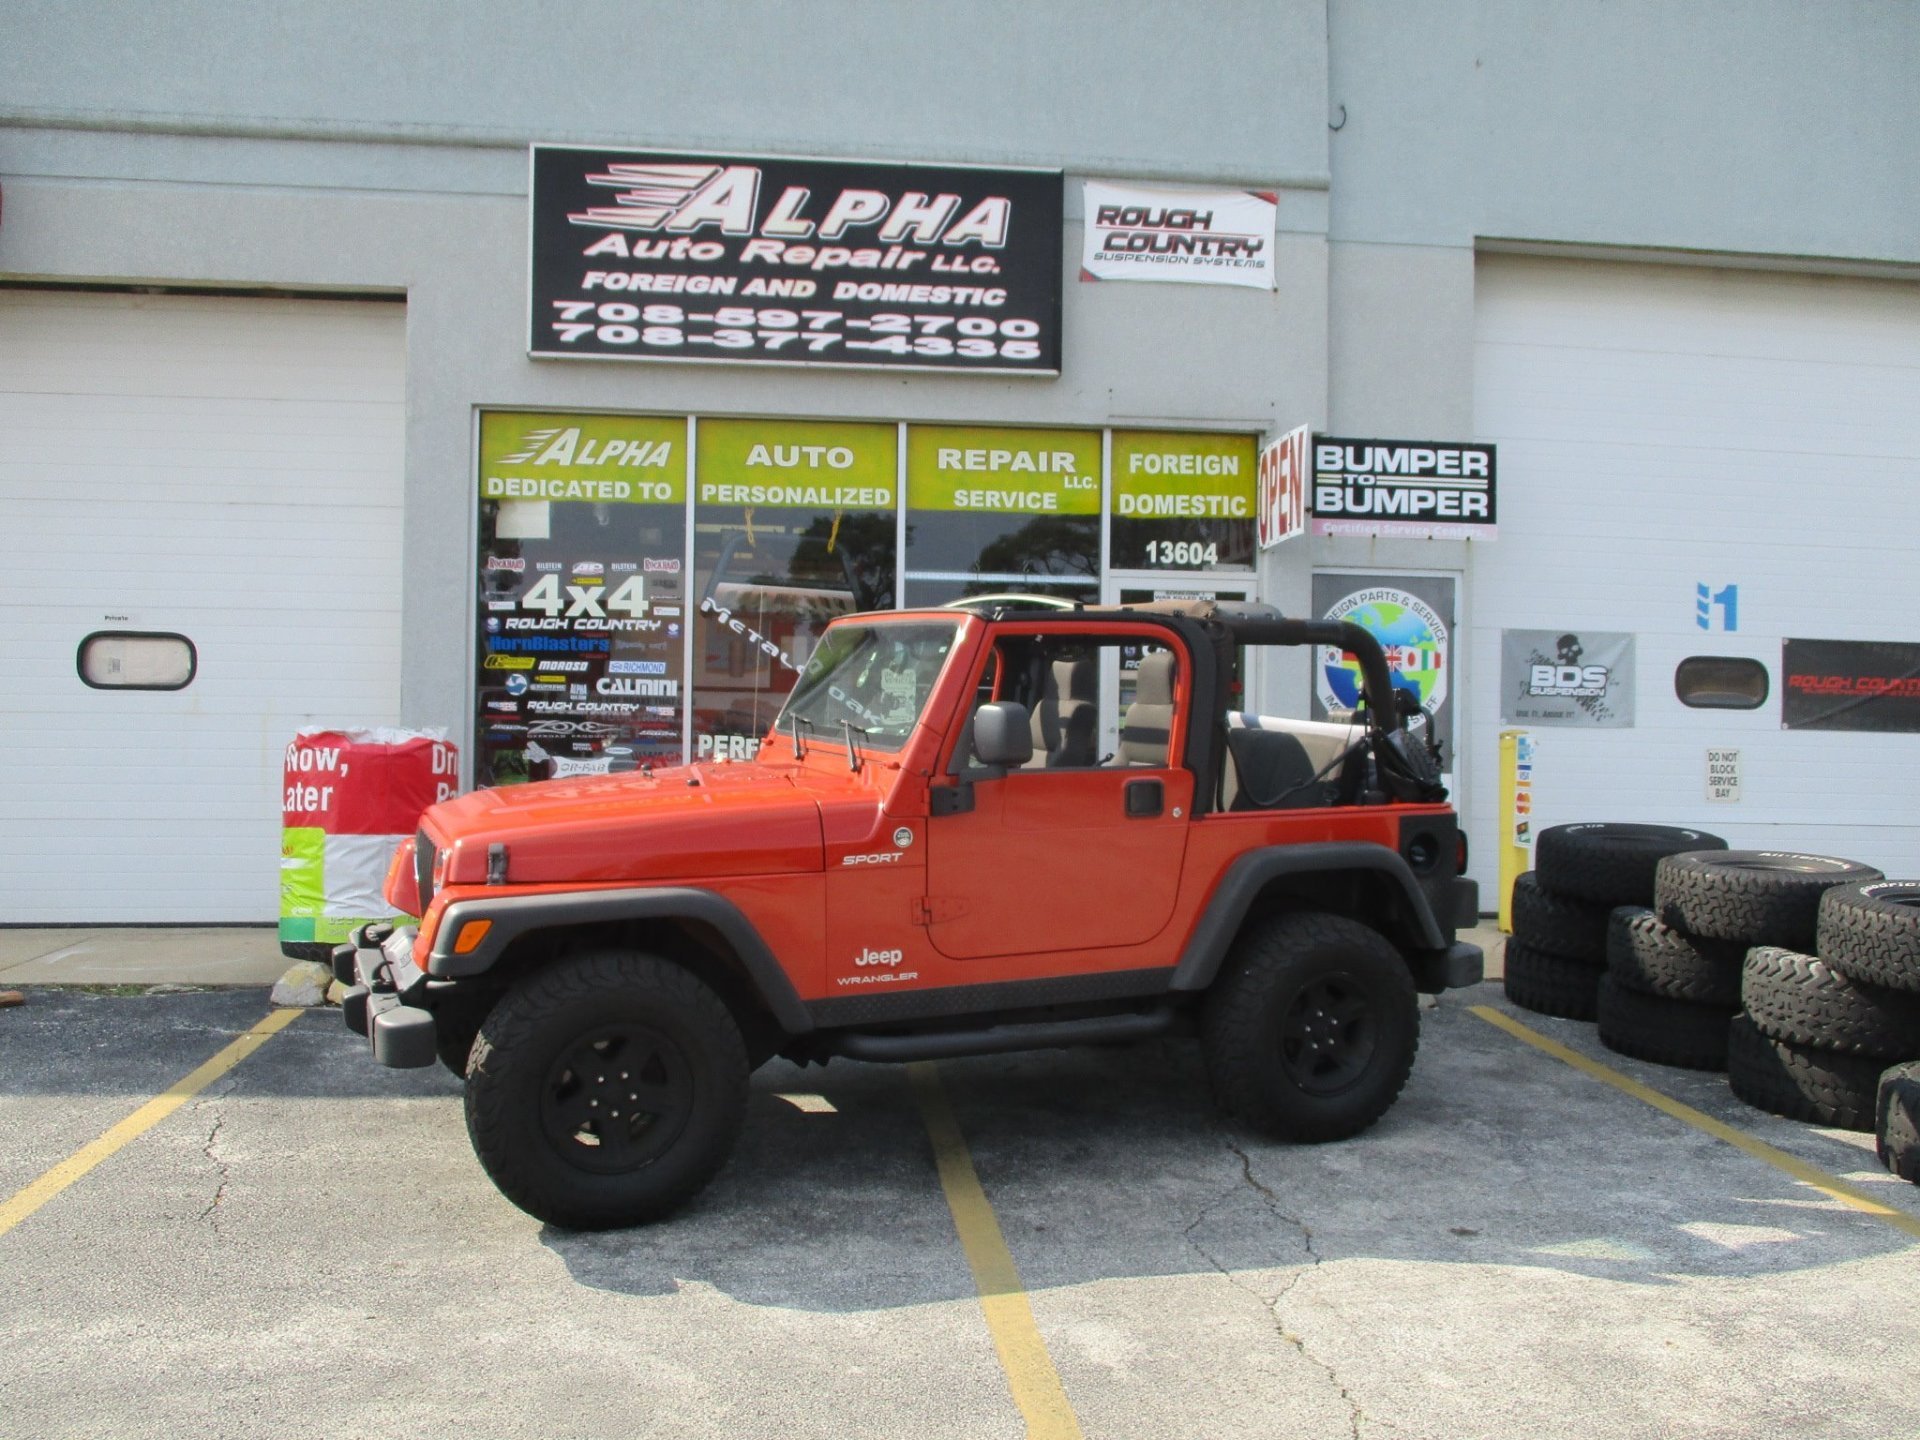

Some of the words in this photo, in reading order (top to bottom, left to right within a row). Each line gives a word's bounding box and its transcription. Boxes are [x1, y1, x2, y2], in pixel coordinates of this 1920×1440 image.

[664, 165, 1011, 248] ALPHA
[1096, 204, 1214, 231] ROUGH
[583, 232, 725, 262] Auto
[739, 238, 927, 271] Repair
[931, 254, 1001, 275] LLC.
[1103, 231, 1265, 258] COUNTRY
[1093, 252, 1190, 264] SUSPENSION
[1193, 256, 1265, 269] SYSTEMS
[581, 270, 737, 295] FOREIGN
[740, 277, 818, 298] AND
[832, 281, 1008, 307] DOMESTIC
[552, 300, 1041, 338] 708-597-2700
[551, 321, 1042, 361] 708-377-4335
[533, 427, 672, 468] ALPHA
[745, 444, 854, 468] AUTO
[937, 448, 1077, 473] REPAIR
[1129, 453, 1239, 475] FOREIGN
[1316, 445, 1488, 477] BUMPER
[487, 477, 631, 499] DEDICATED
[638, 482, 673, 500] TO
[1063, 475, 1097, 490] LLC.
[1258, 430, 1305, 546] OPEN
[1343, 474, 1376, 486] TO
[701, 484, 891, 506] PERSONALIZED
[954, 490, 1057, 510] SERVICE
[1119, 494, 1247, 516] DOMESTIC
[1316, 486, 1488, 518] BUMPER
[1146, 540, 1218, 566] 13604
[522, 574, 649, 618] 4x4
[1360, 591, 1399, 603] PARTS
[1401, 597, 1410, 608] &
[1410, 601, 1447, 644] SERVICE
[1713, 584, 1738, 631] 1
[505, 617, 568, 630] ROUGH
[573, 618, 661, 631] COUNTRY
[489, 636, 610, 651] HornBlasters
[538, 660, 589, 671] MOROSO
[623, 662, 665, 673] RICHMOND
[1529, 664, 1608, 689] BDS
[596, 677, 678, 697] CALMINI
[1528, 686, 1606, 697] SUSPENSION
[1788, 675, 1852, 690] ROUGH
[527, 700, 573, 711] ROUGH
[576, 702, 640, 713] COUNTRY
[286, 744, 348, 777] Now,
[1709, 752, 1720, 762] DO
[1722, 752, 1737, 762] NOT
[1710, 764, 1736, 774] BLOCK
[1709, 776, 1738, 786] SERVICE
[282, 782, 334, 813] ater
[1715, 788, 1730, 798] BAY
[842, 852, 904, 866] SPORT
[855, 948, 903, 967] Jeep
[837, 972, 919, 986] WRANGLER
